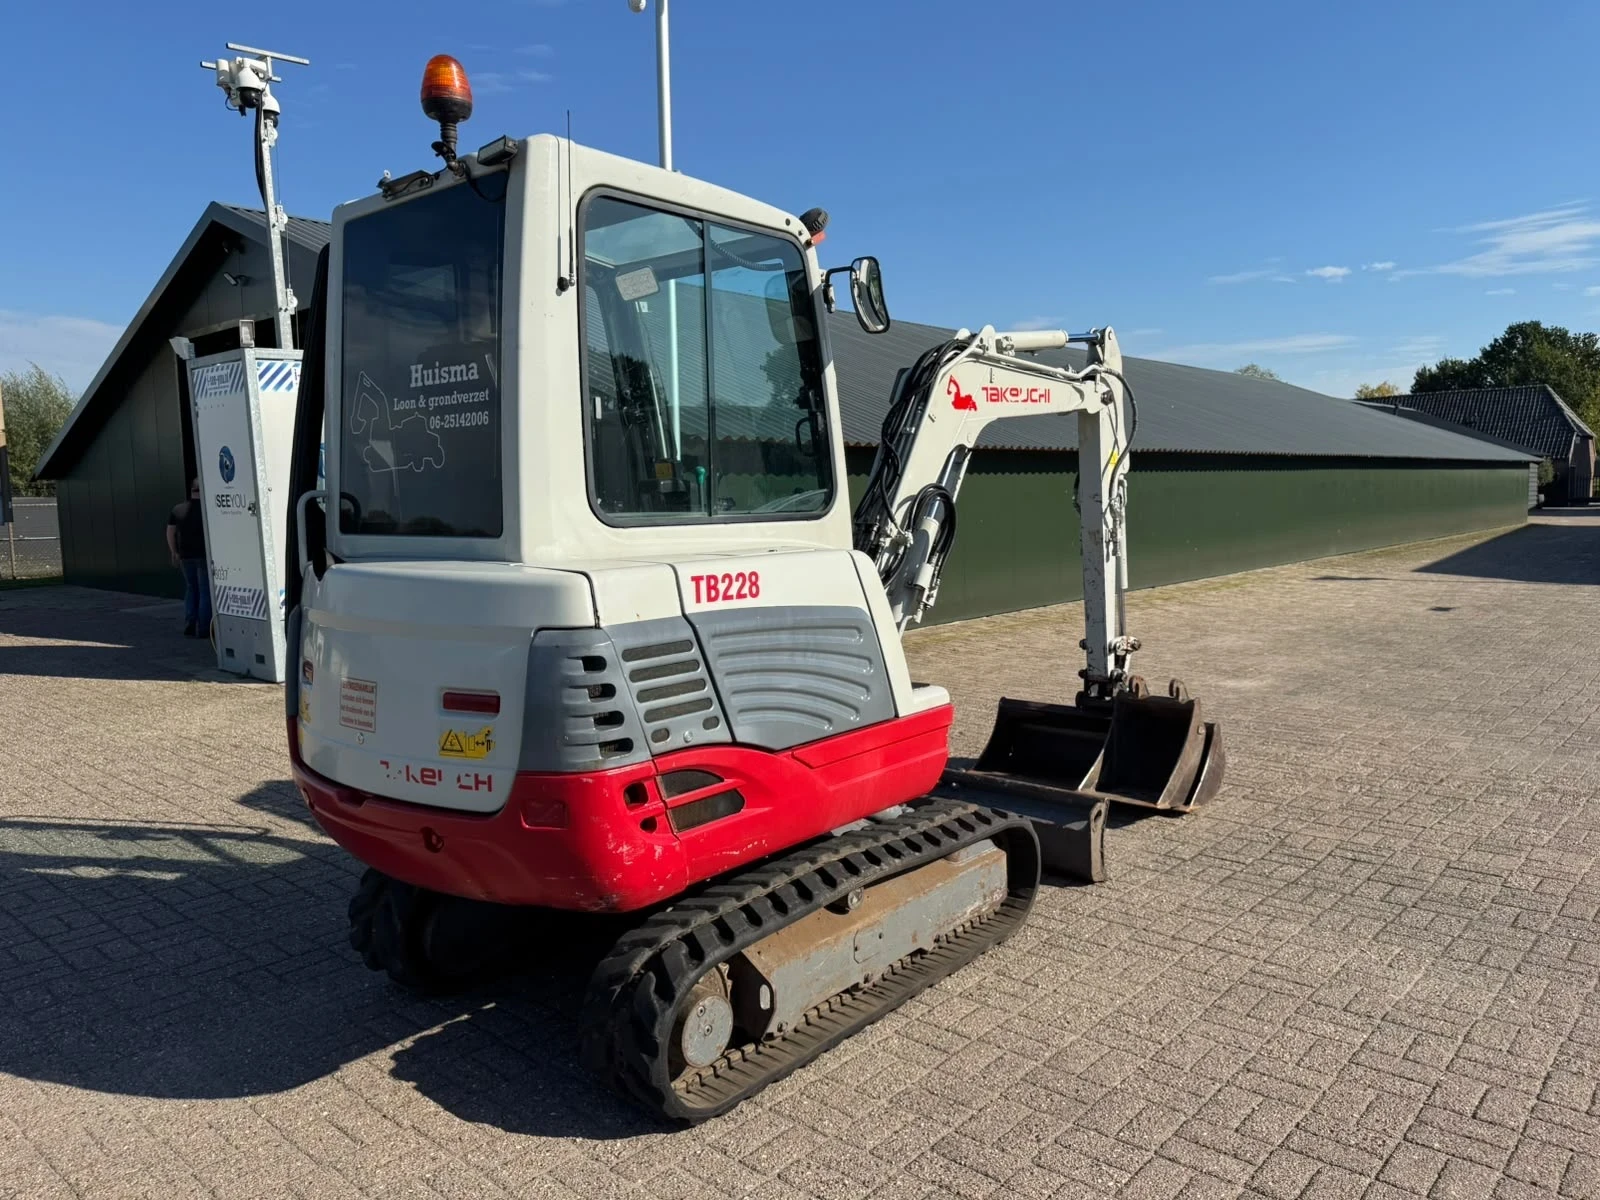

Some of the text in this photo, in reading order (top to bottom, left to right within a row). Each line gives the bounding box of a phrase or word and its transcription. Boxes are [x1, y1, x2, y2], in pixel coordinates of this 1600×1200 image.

[409, 361, 479, 388] Huisma
[393, 388, 490, 411] Loon & grondverzet
[429, 411, 489, 429] 06-25142006
[690, 571, 760, 604] TB228
